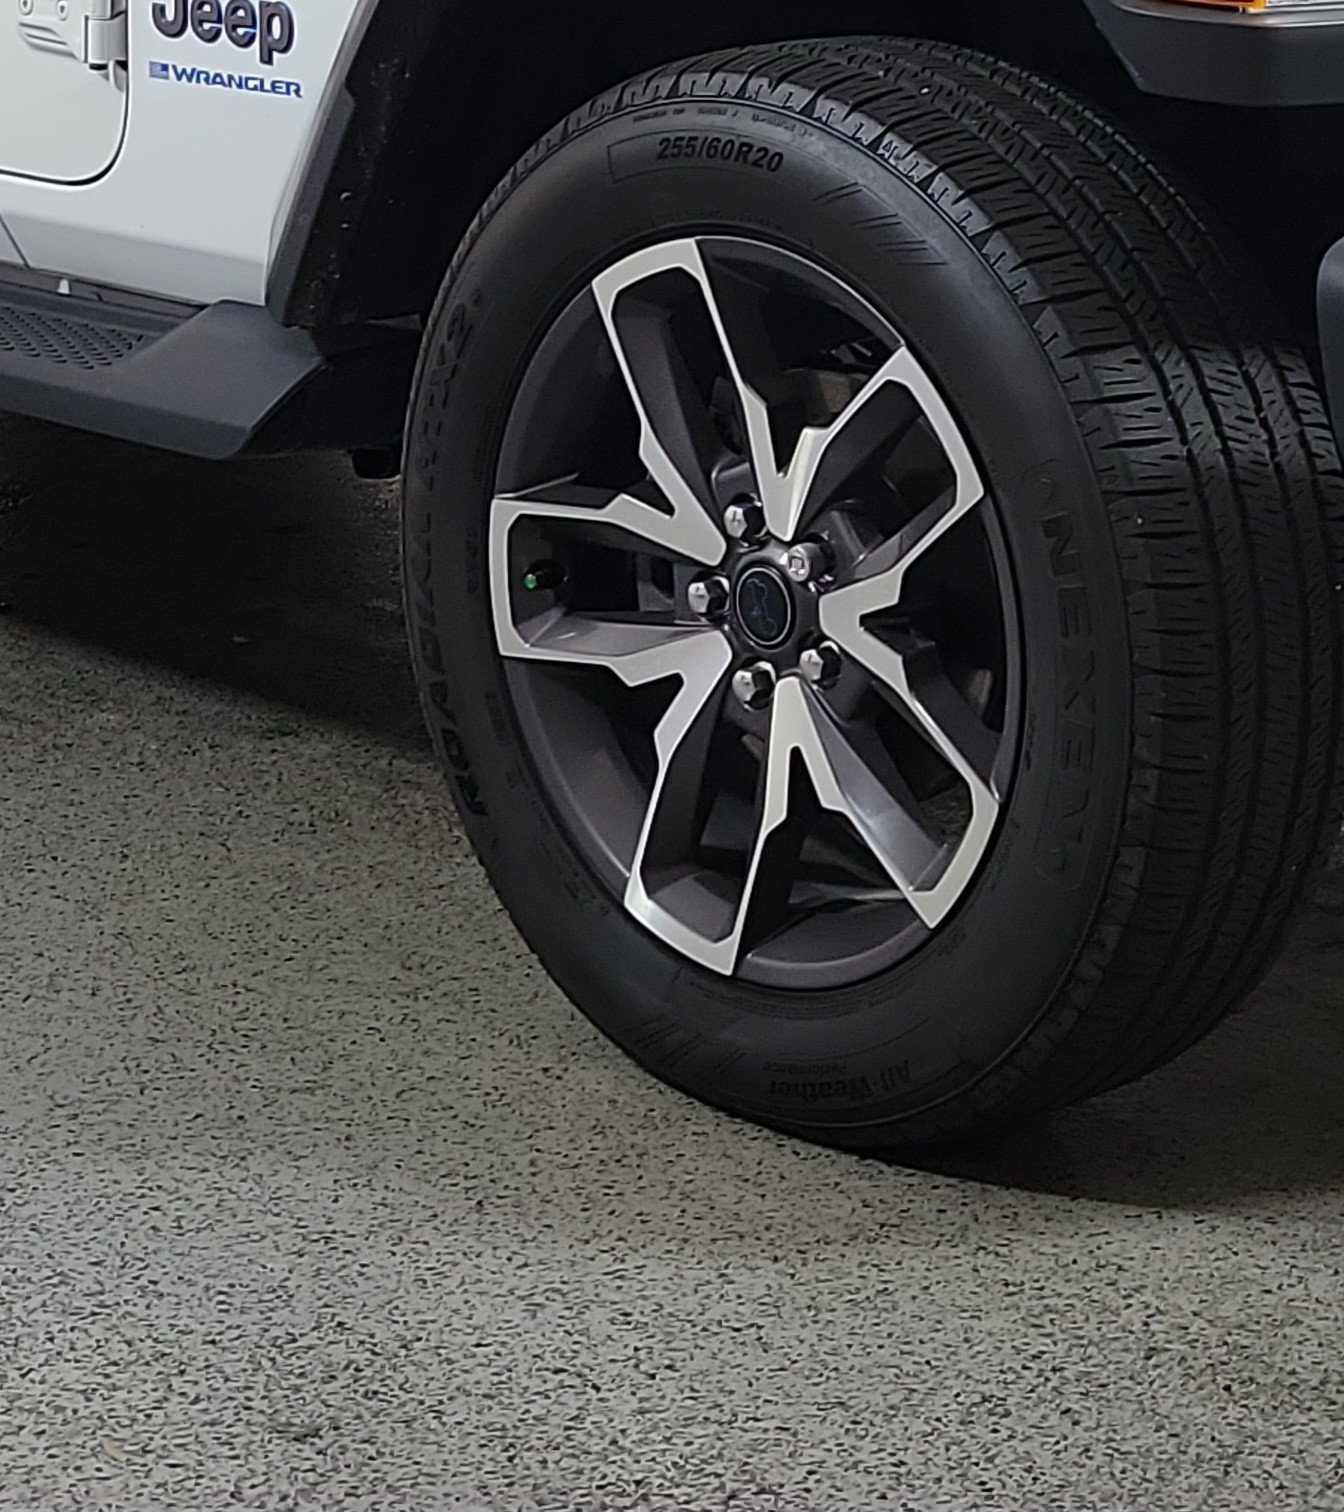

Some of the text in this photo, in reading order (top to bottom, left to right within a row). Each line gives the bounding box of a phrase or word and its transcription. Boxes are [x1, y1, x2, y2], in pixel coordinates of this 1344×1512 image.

[171, 63, 304, 100] WRANGLER
[656, 135, 784, 173] 255/60R20
[1040, 510, 1097, 845] NEXEN
